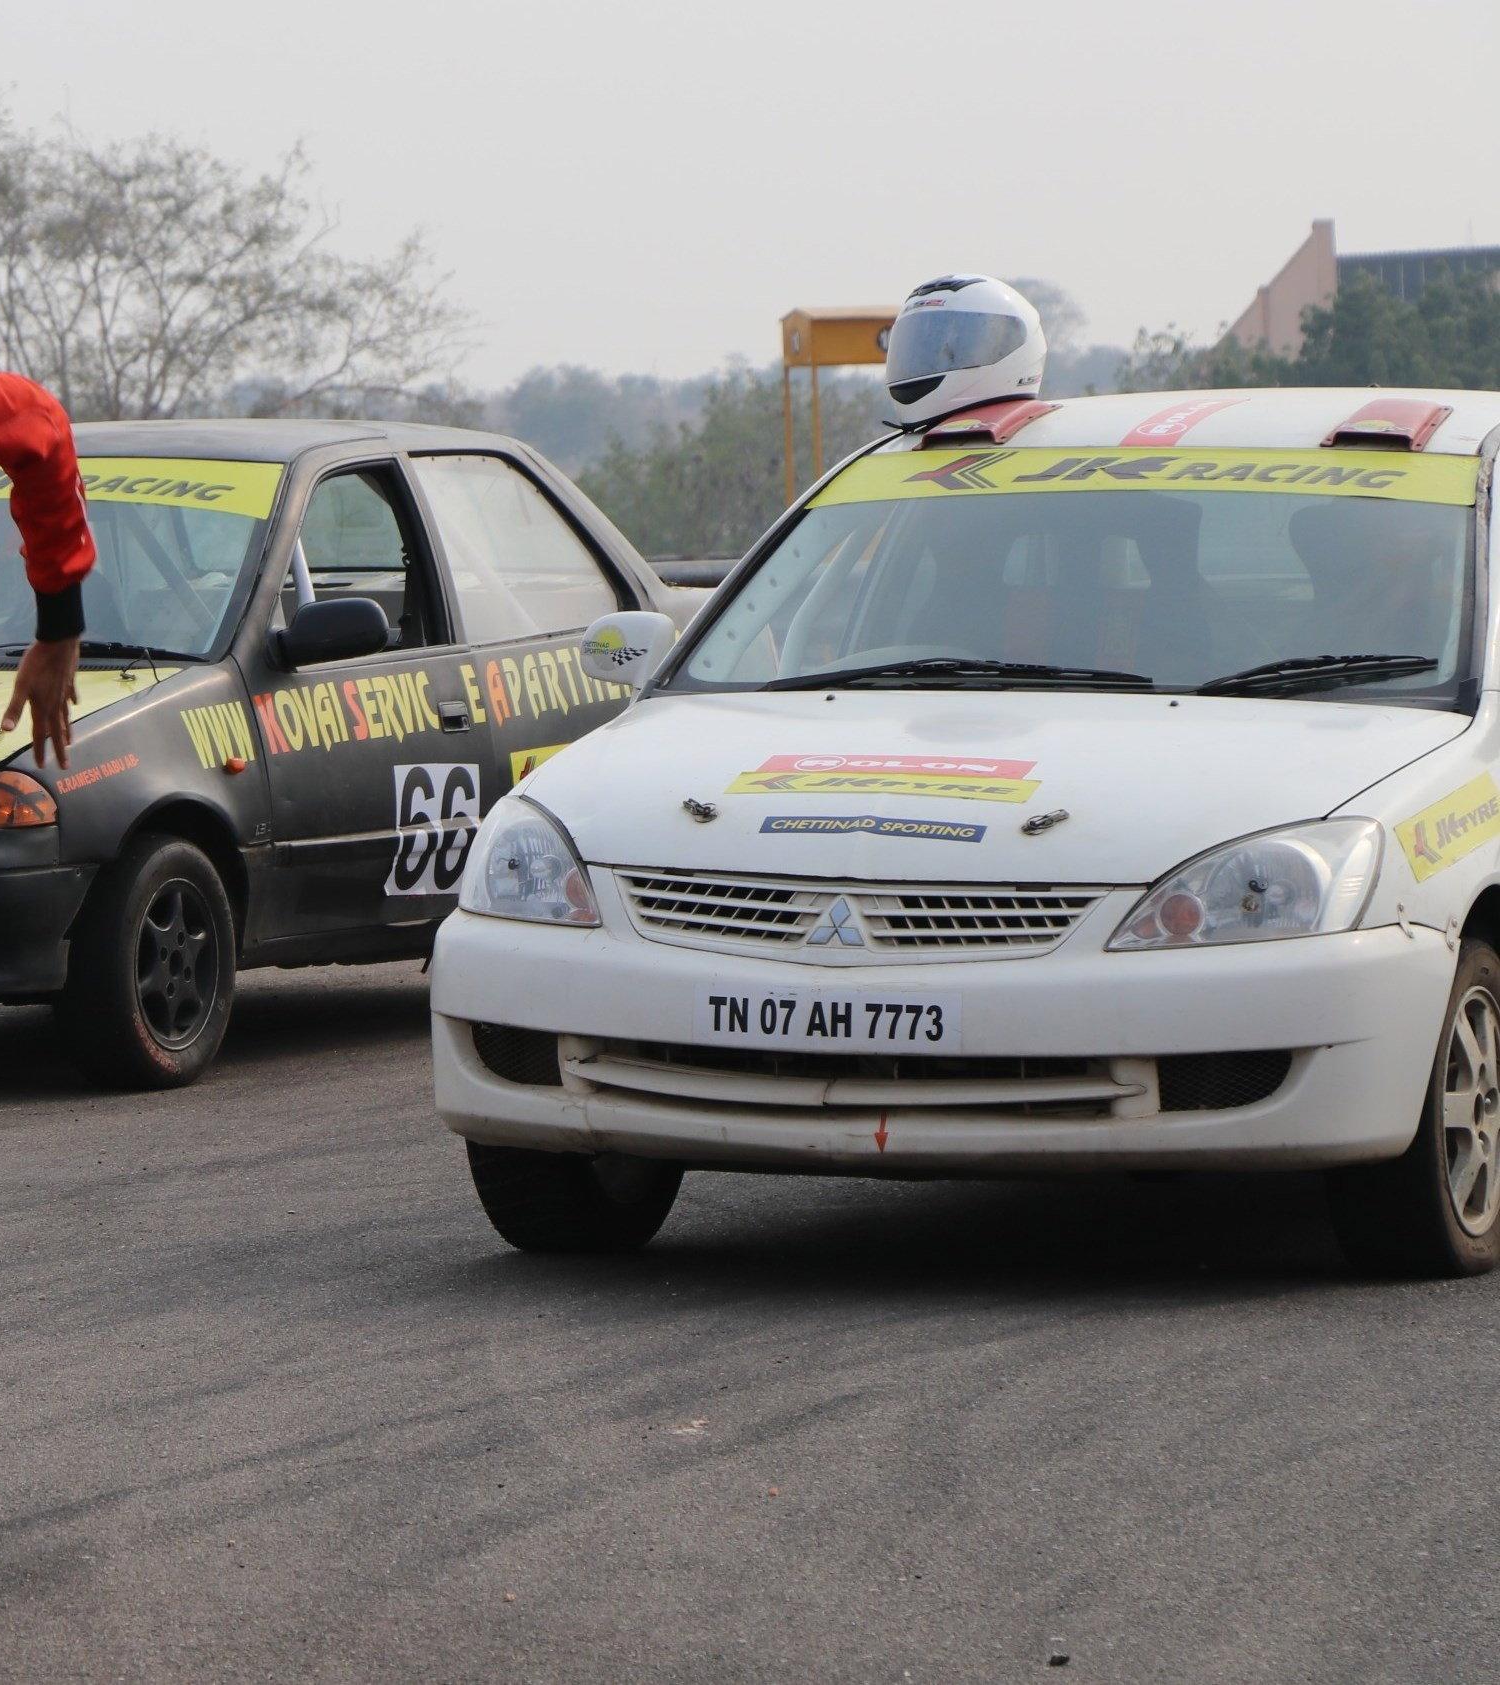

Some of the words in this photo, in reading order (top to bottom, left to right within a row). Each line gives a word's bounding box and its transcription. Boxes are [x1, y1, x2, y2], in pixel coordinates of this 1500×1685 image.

[1012, 456, 1181, 482] JK
[1165, 462, 1406, 489] RACING
[179, 701, 256, 769] WWW
[253, 681, 350, 755] KOVAI
[485, 646, 633, 728] APART
[56, 766, 103, 795] R.RAMESH
[100, 757, 127, 778] BABU
[794, 755, 998, 773] ROLON
[394, 766, 477, 890] 66
[771, 817, 876, 830] CHETTINAD
[879, 821, 977, 838] SPORTING
[708, 995, 750, 1033] TN
[760, 998, 797, 1036] 07
[806, 1001, 853, 1038] AH
[865, 1003, 944, 1042] 7773
